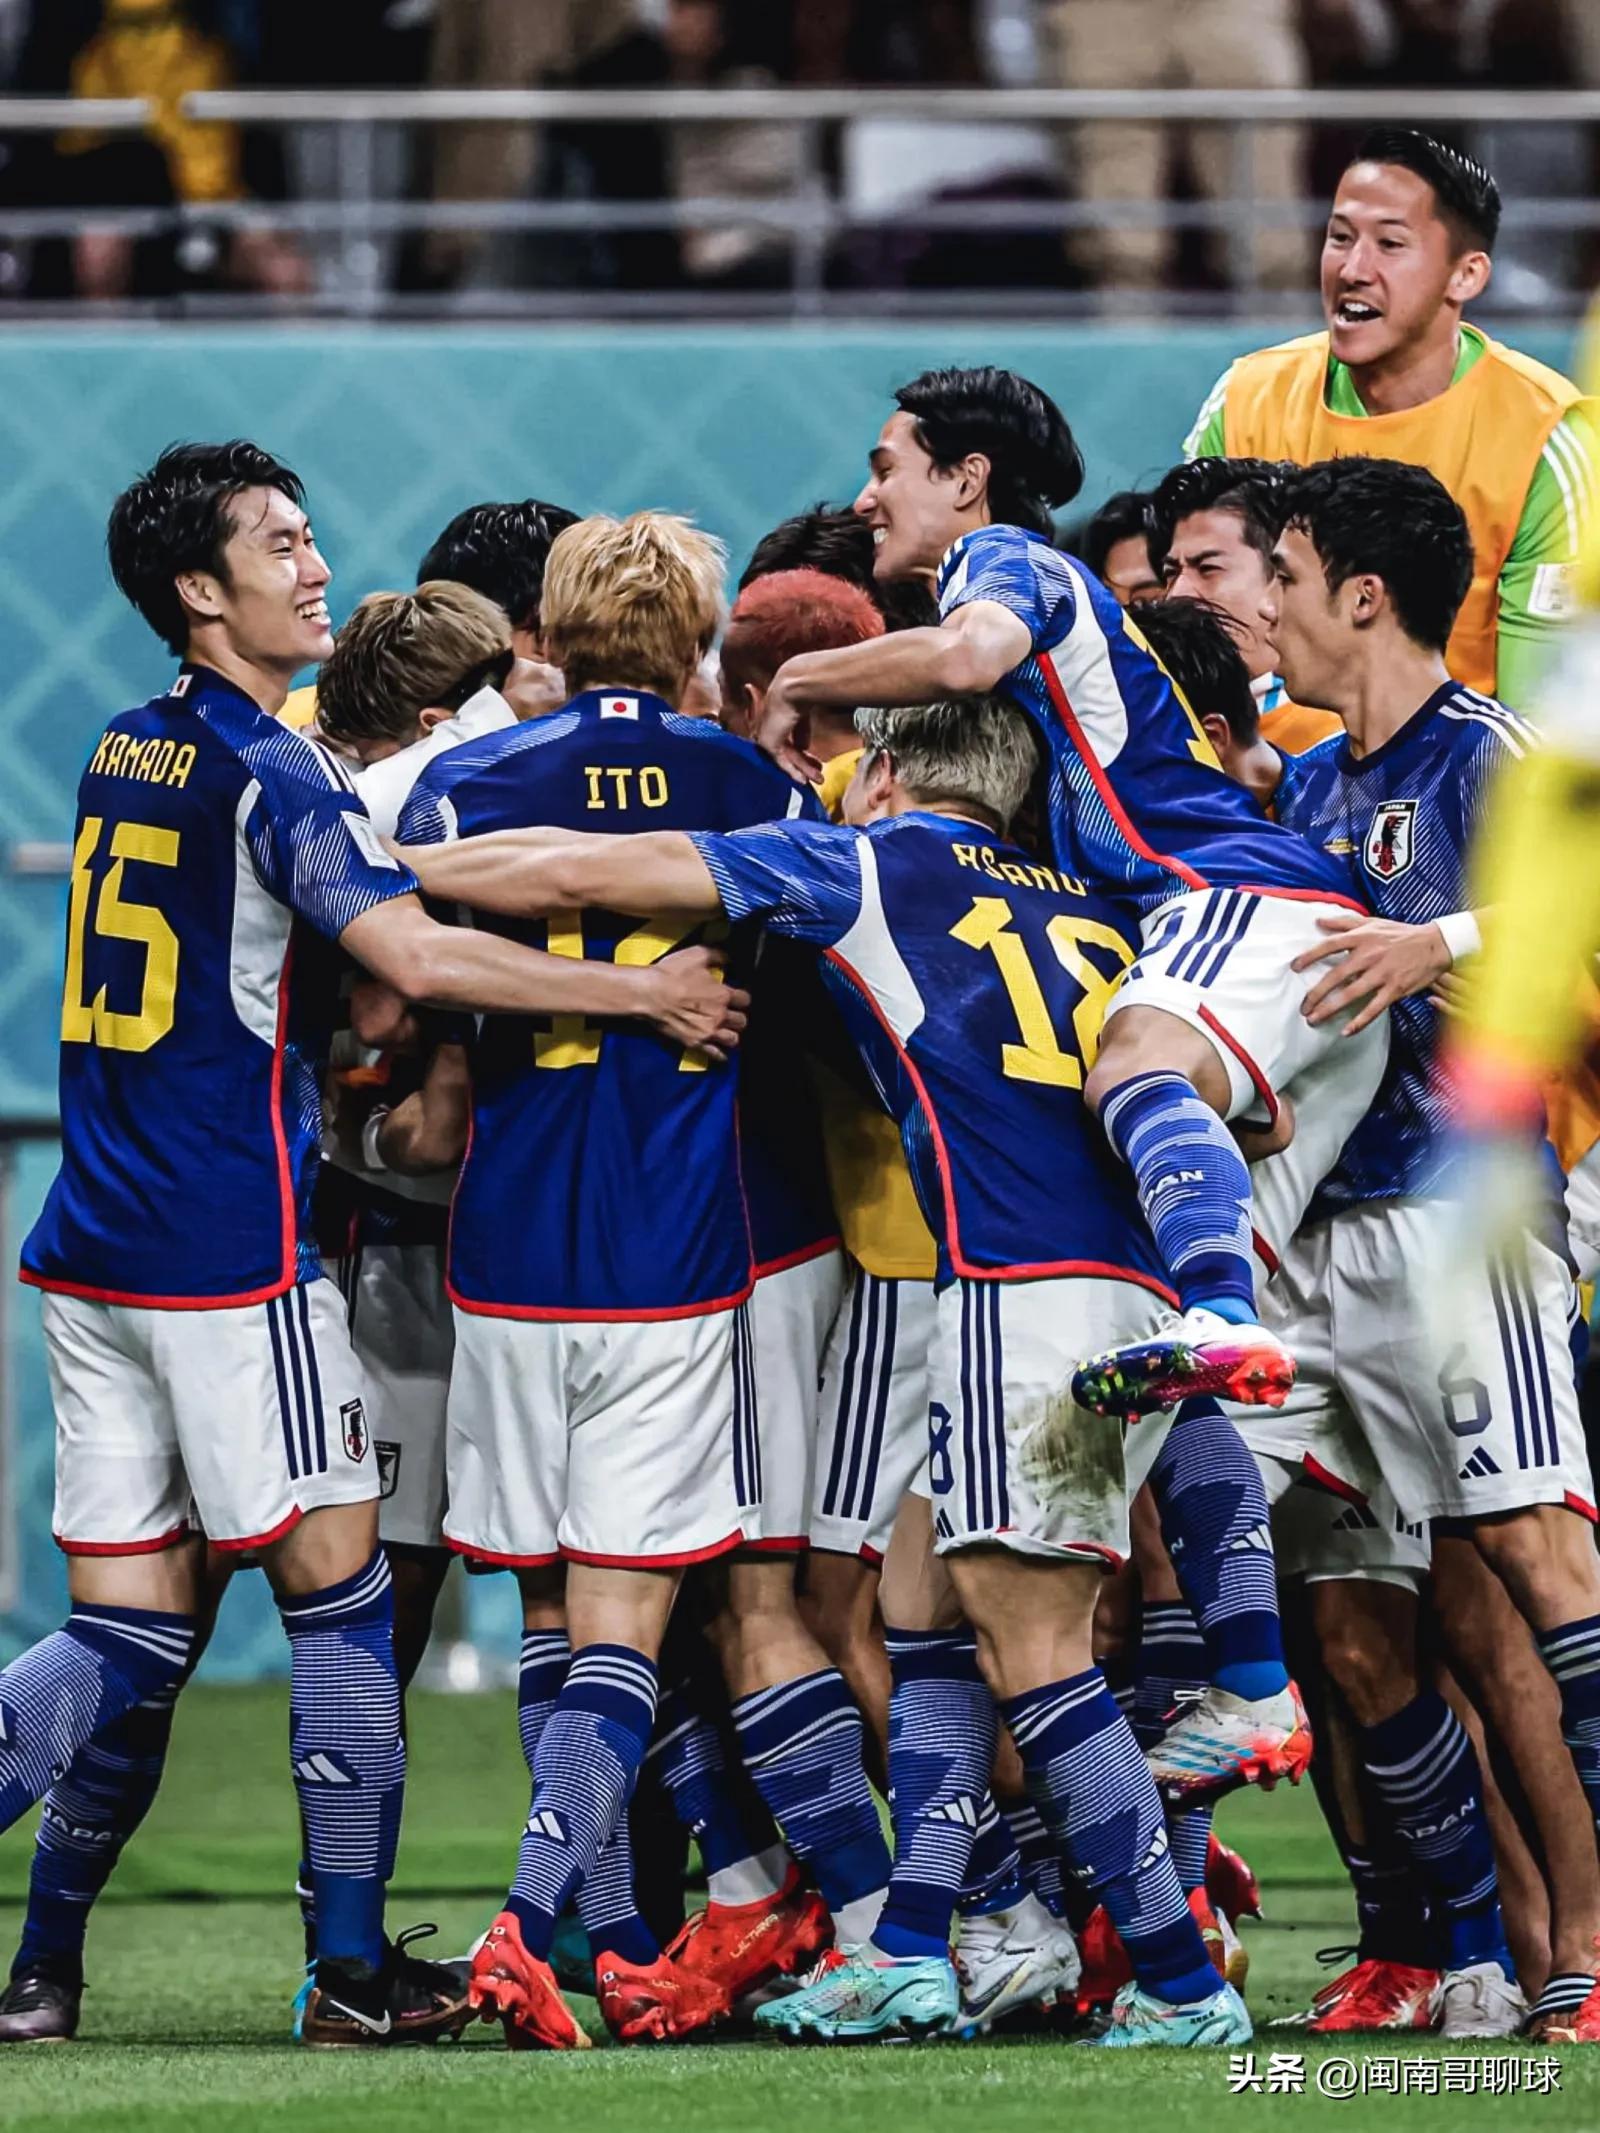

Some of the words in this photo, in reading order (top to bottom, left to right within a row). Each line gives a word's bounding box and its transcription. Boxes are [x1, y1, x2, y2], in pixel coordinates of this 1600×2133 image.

[89, 731, 197, 789] KAMADA
[584, 765, 670, 810] ITO
[951, 842, 1088, 897] ASANO
[60, 816, 181, 1053] 15
[948, 896, 1136, 1090] 18
[1437, 1341, 1493, 1438] 6
